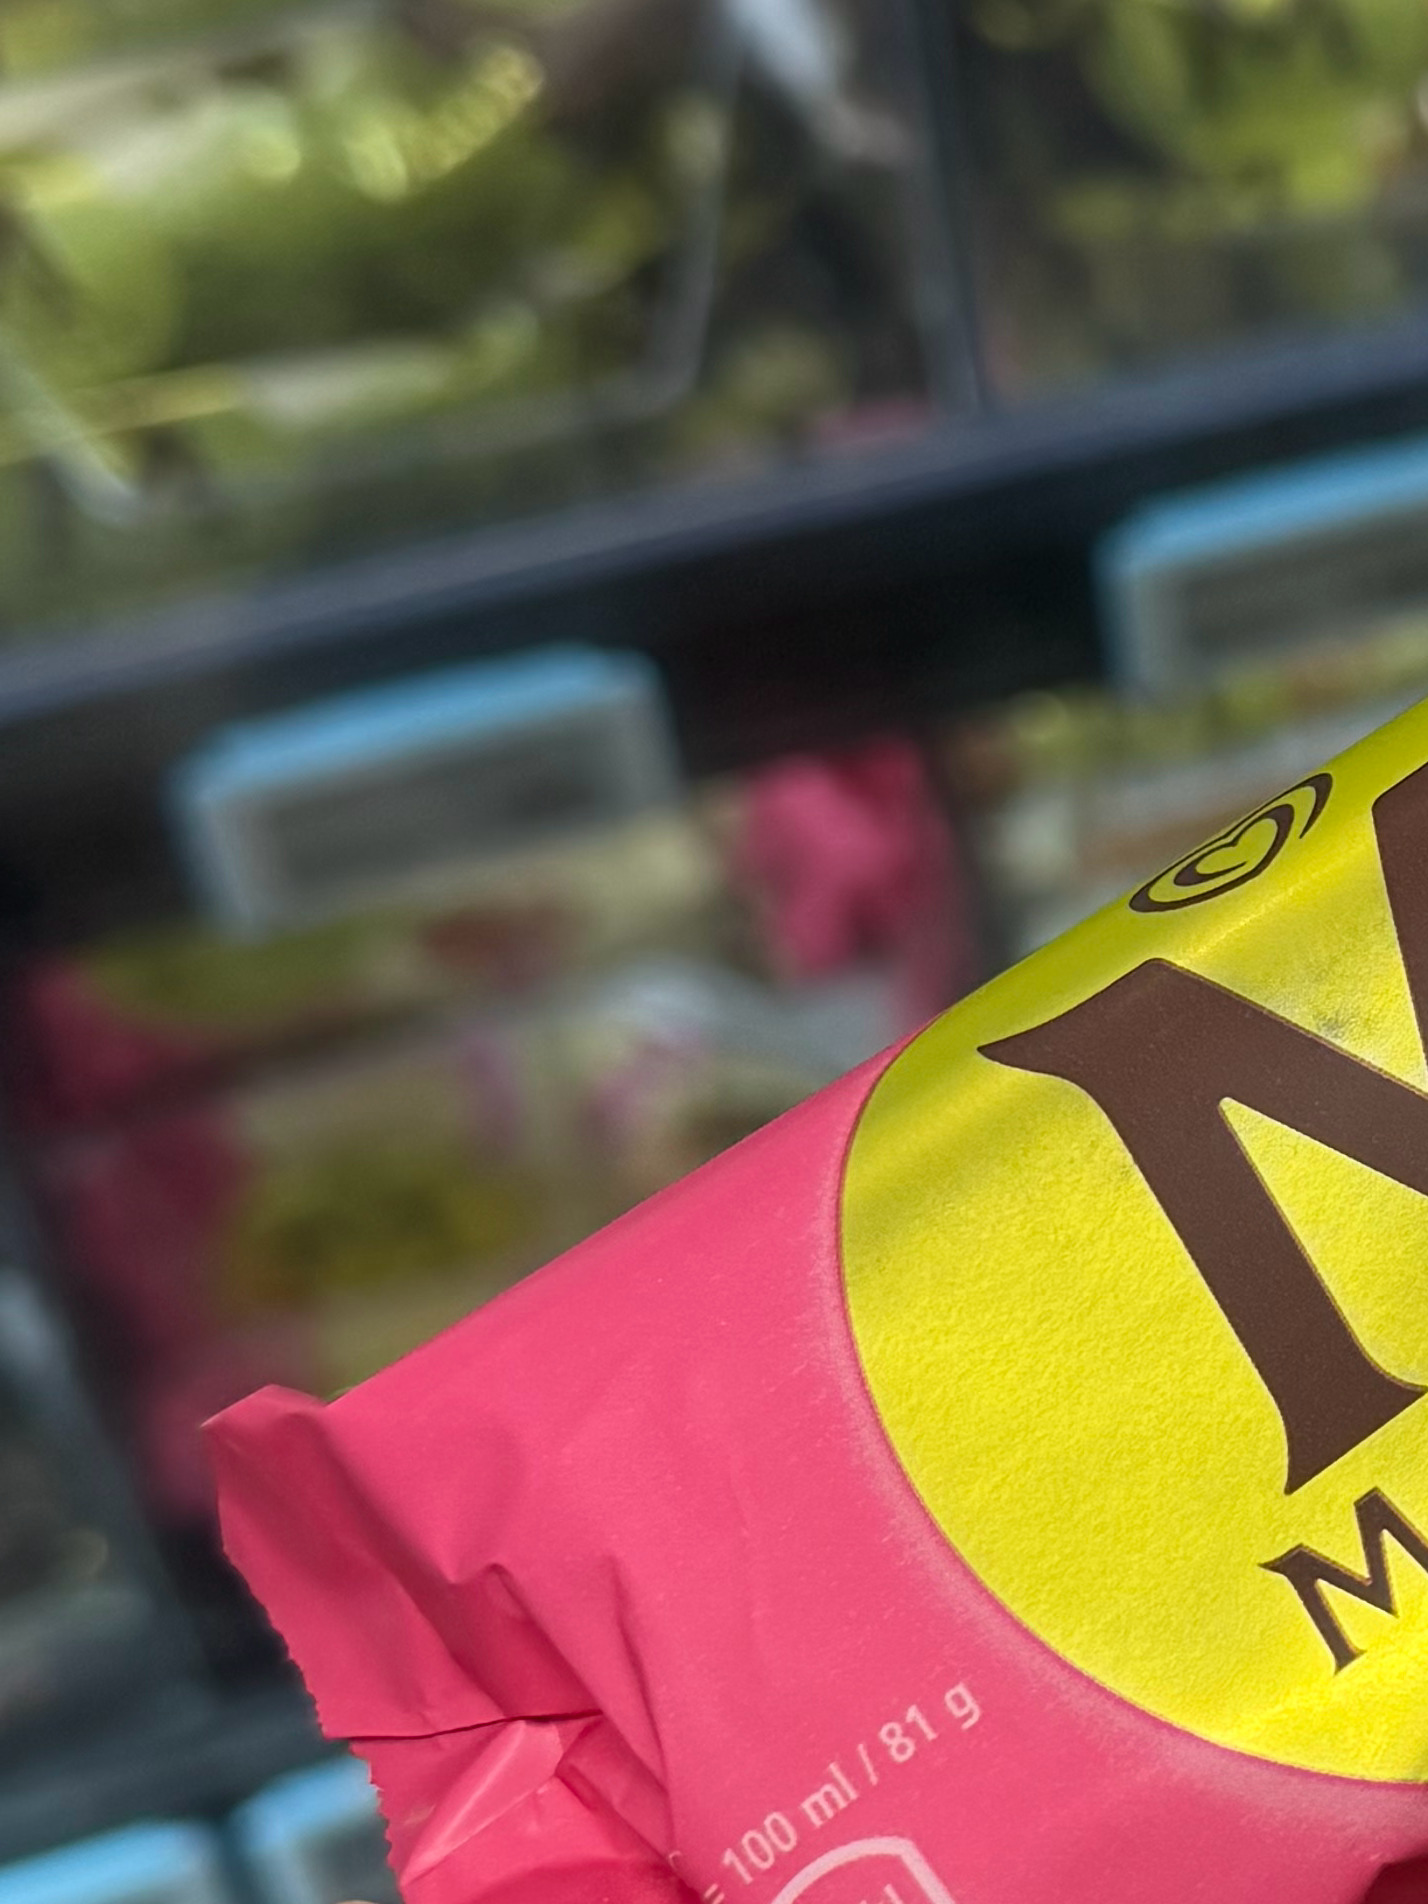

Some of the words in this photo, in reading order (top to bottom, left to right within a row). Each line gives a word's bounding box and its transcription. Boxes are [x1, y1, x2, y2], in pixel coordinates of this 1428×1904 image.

[722, 1811, 798, 1885] 100
[801, 1760, 860, 1829] ml
[858, 1742, 880, 1786] /
[878, 1704, 939, 1764] 81
[944, 1681, 982, 1730] g
